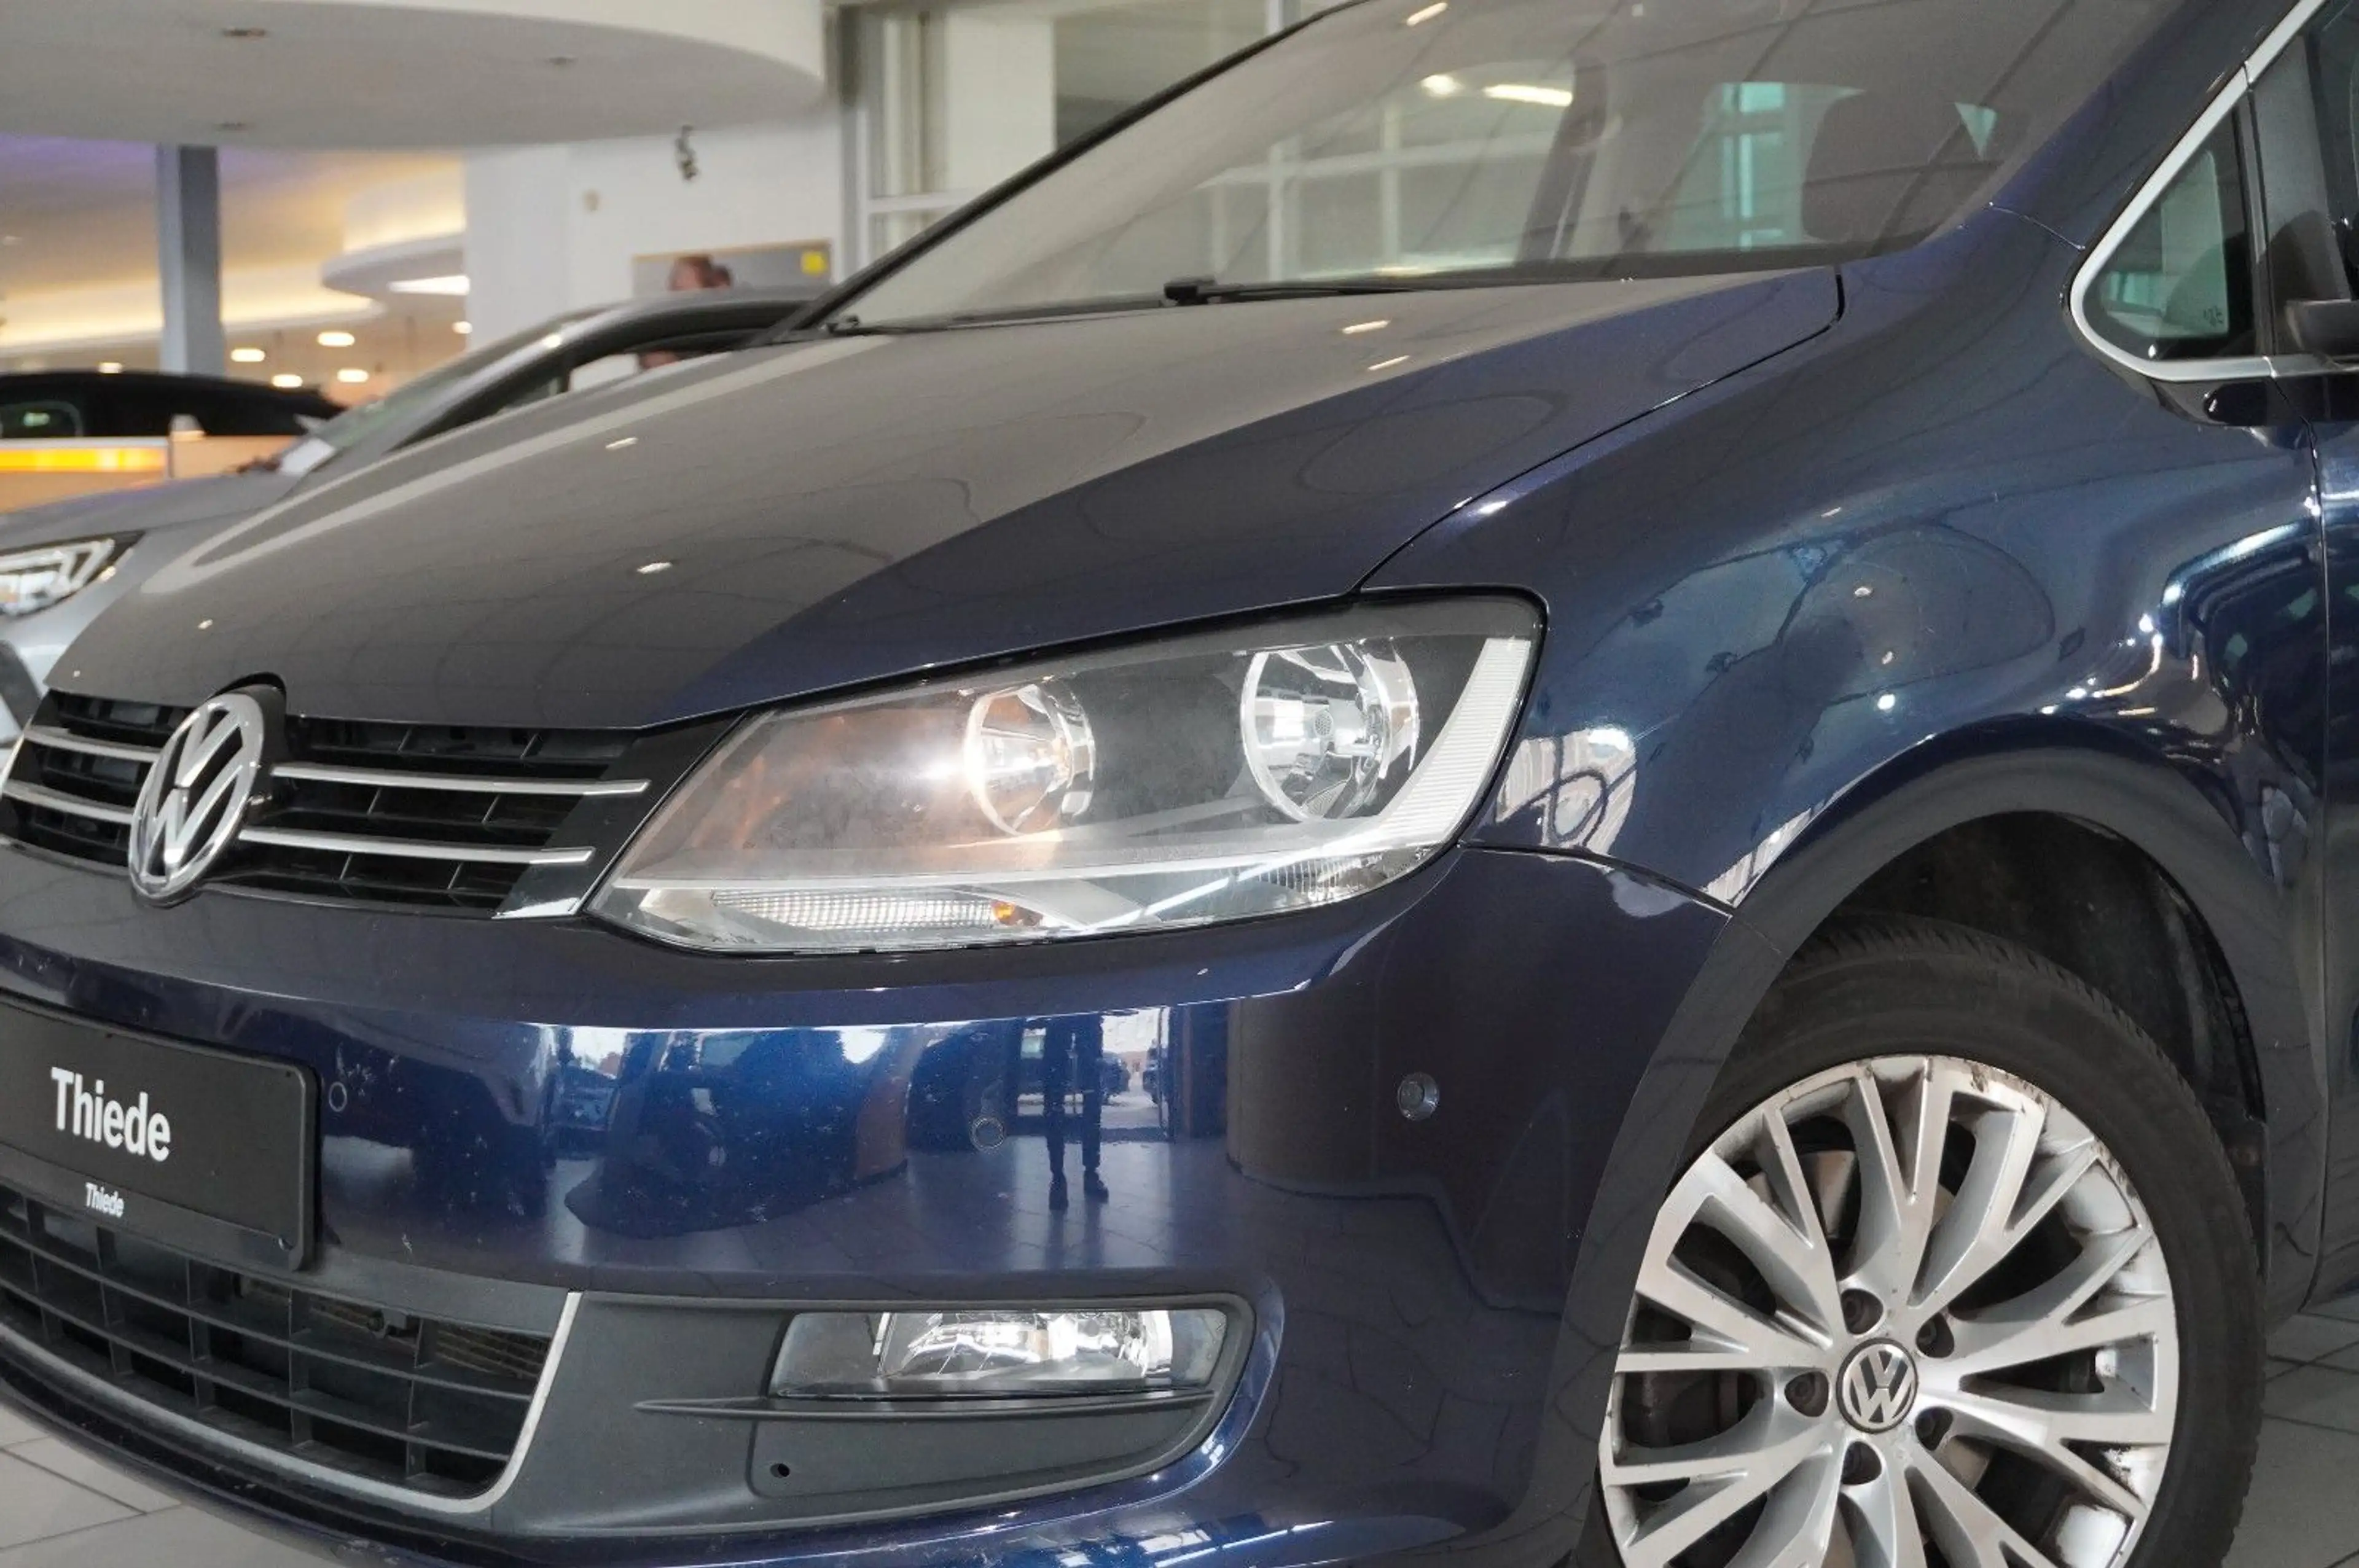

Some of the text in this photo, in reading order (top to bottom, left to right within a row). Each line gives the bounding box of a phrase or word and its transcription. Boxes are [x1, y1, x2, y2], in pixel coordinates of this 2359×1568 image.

[130, 693, 264, 899] VW
[50, 1066, 171, 1161] Thiede
[85, 1182, 125, 1218] Thiede
[1841, 1341, 1917, 1432] VW
